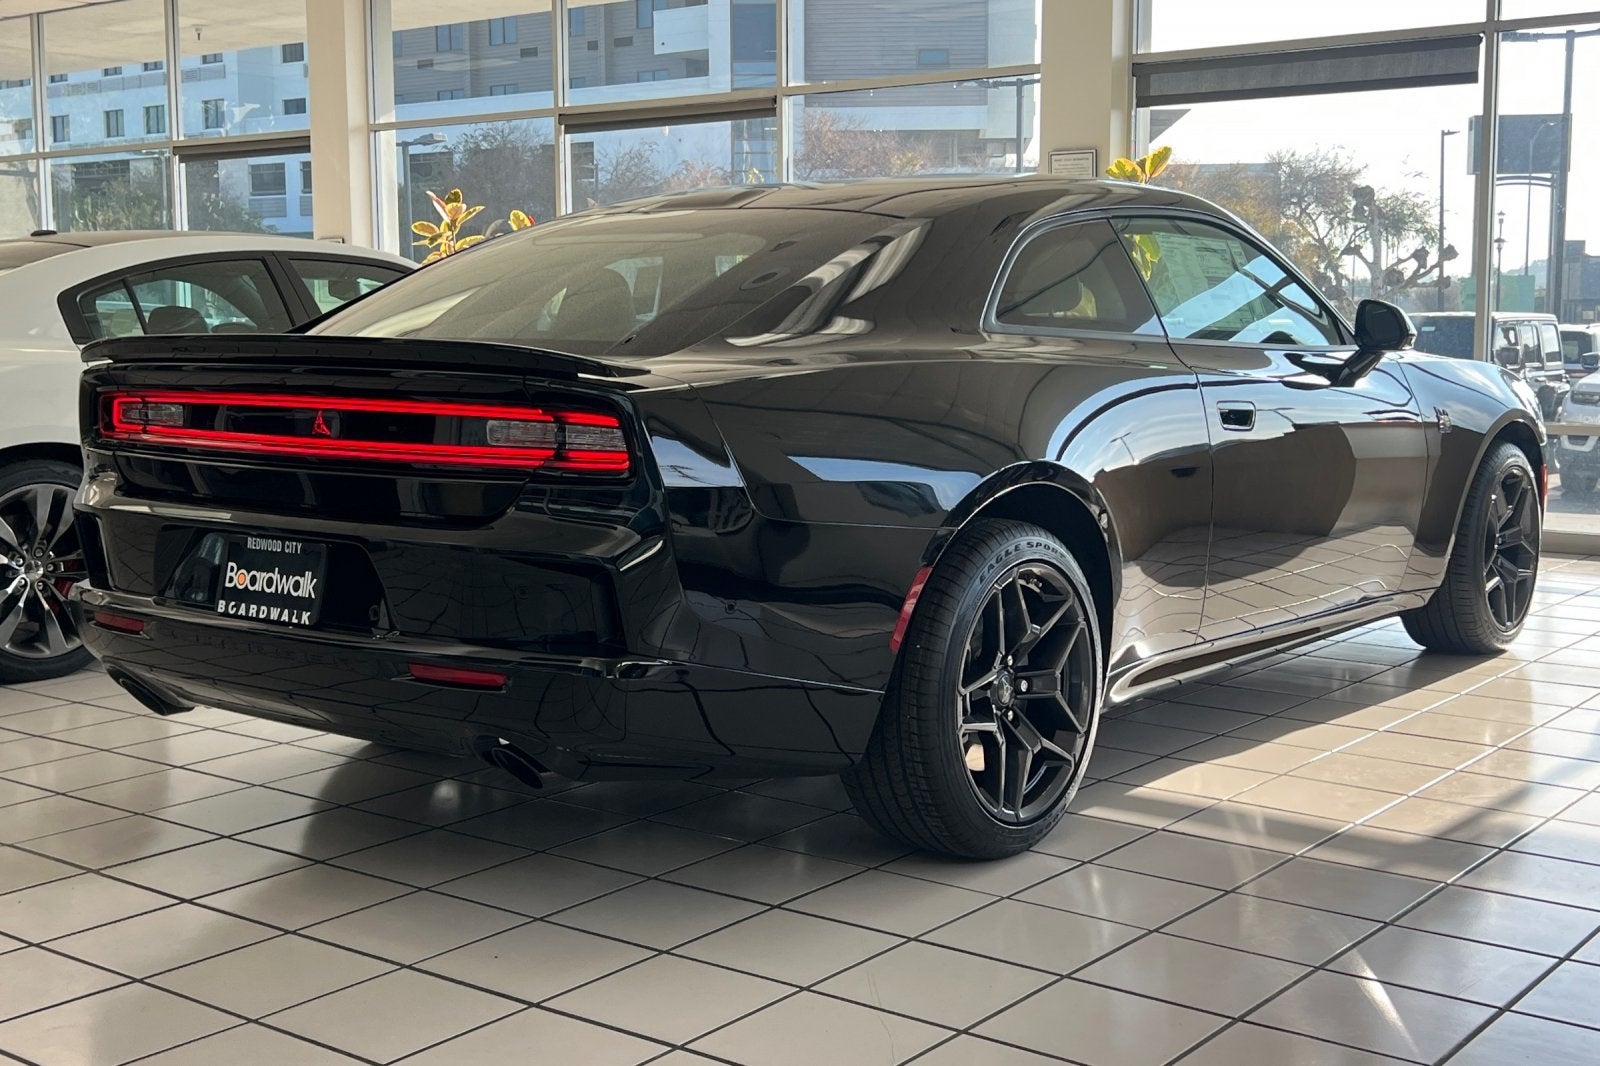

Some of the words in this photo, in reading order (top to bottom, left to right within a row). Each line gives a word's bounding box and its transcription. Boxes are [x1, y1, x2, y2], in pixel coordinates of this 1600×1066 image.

[247, 537, 282, 552] REDWOOD
[284, 541, 302, 554] CITY
[225, 562, 317, 598] Boardwalk
[979, 543, 1022, 585] EAGLE
